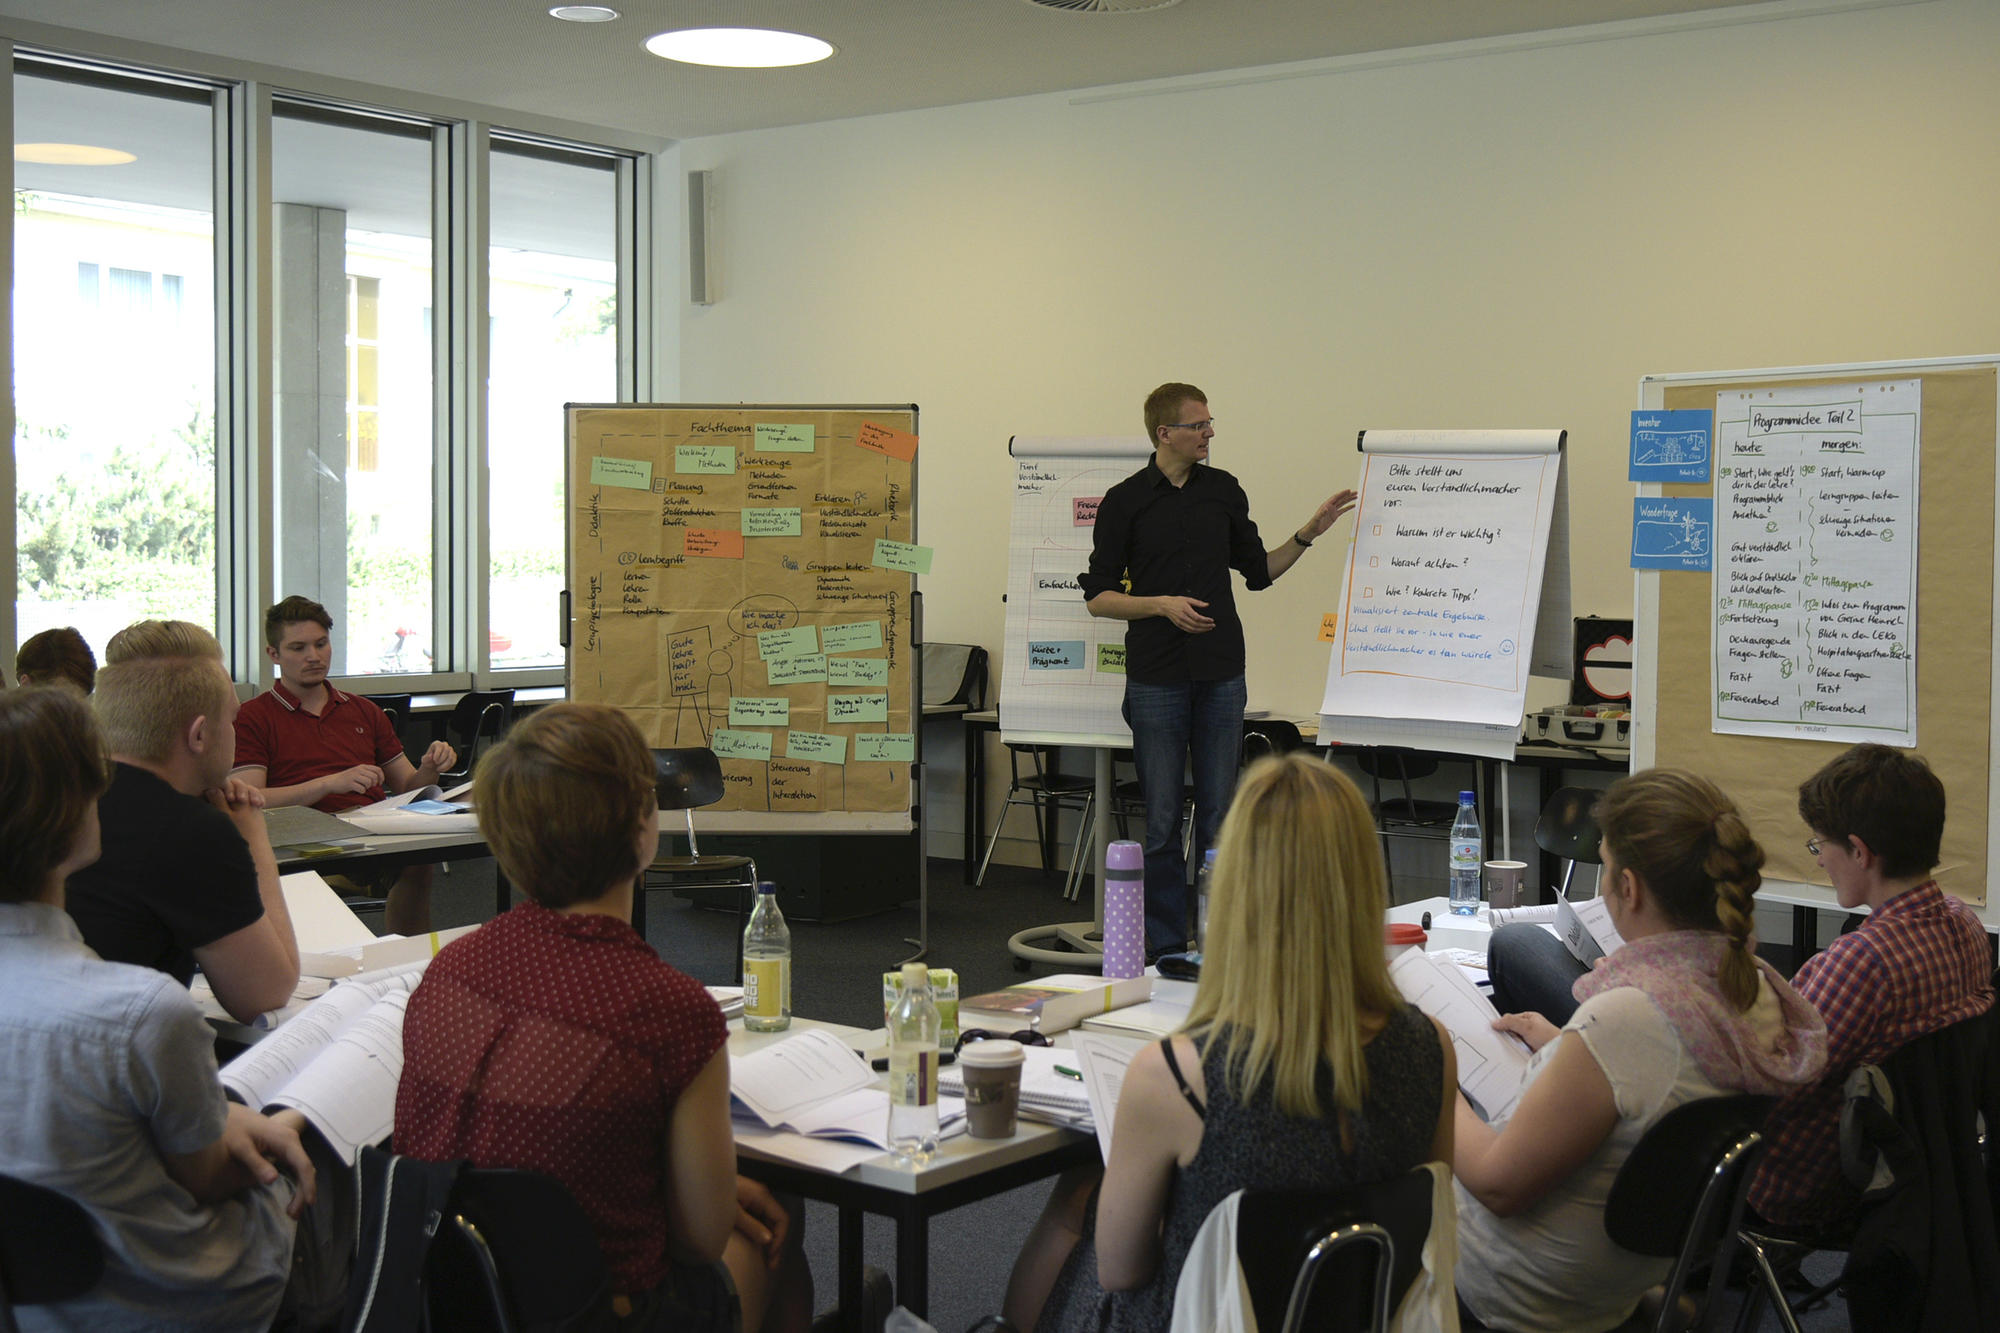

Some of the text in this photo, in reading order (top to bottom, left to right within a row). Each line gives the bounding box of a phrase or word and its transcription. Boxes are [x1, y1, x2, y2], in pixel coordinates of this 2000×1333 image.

[1754, 409, 1855, 432] Programmidee Teil 2
[691, 422, 752, 434] Fachthema
[1734, 441, 1762, 452] heute
[744, 458, 792, 470] Werkzeuge
[749, 471, 786, 480] Methoden
[1389, 464, 1463, 477] Bitte stellt uns
[1820, 466, 1843, 479] Start,
[669, 482, 704, 495] Planung
[1386, 484, 1416, 492] euren
[1753, 481, 1766, 490] der
[889, 483, 900, 521] Rhetorik
[588, 494, 599, 538] Didaktik
[1076, 510, 1096, 520] Rede
[1396, 524, 1428, 537] Warum
[1432, 526, 1444, 537] ist
[1446, 530, 1457, 538] er
[1732, 541, 1792, 552] Gut verständlich
[639, 554, 686, 568] Lernbegriff
[806, 561, 842, 572] Gruppen
[1392, 556, 1420, 568] Worauf
[1731, 571, 1748, 582] Blick
[1750, 572, 1764, 582] auf
[623, 584, 649, 593] Lehren
[1039, 579, 1084, 590] Einfachhei
[1822, 576, 1874, 592] Mittagspause
[1413, 586, 1448, 598] Konkrete
[1452, 588, 1478, 604] Tipps!
[1738, 598, 1792, 613] Mittagspause
[1842, 602, 1860, 610] zum
[1863, 600, 1906, 615] Programm
[742, 610, 786, 620] Wie mache
[1354, 606, 1398, 616] Visualisiert
[1402, 608, 1438, 618] zentrale
[746, 622, 760, 630] ich
[1730, 614, 1778, 628] Fortsetzung
[1374, 624, 1392, 634] stellt
[1818, 628, 1838, 639] Blick
[671, 638, 694, 649] Gute
[672, 650, 694, 660] Lehre
[1729, 648, 1757, 662] Fragen
[674, 673, 690, 682] für
[1730, 672, 1753, 682] Fazit
[1844, 669, 1871, 682] Fragen
[1816, 683, 1841, 694] Fazit
[1730, 692, 1780, 706] Feierabend
[1816, 702, 1866, 715] Feierabend
[732, 740, 769, 750] Motivation
[770, 762, 811, 775] Steuerung
